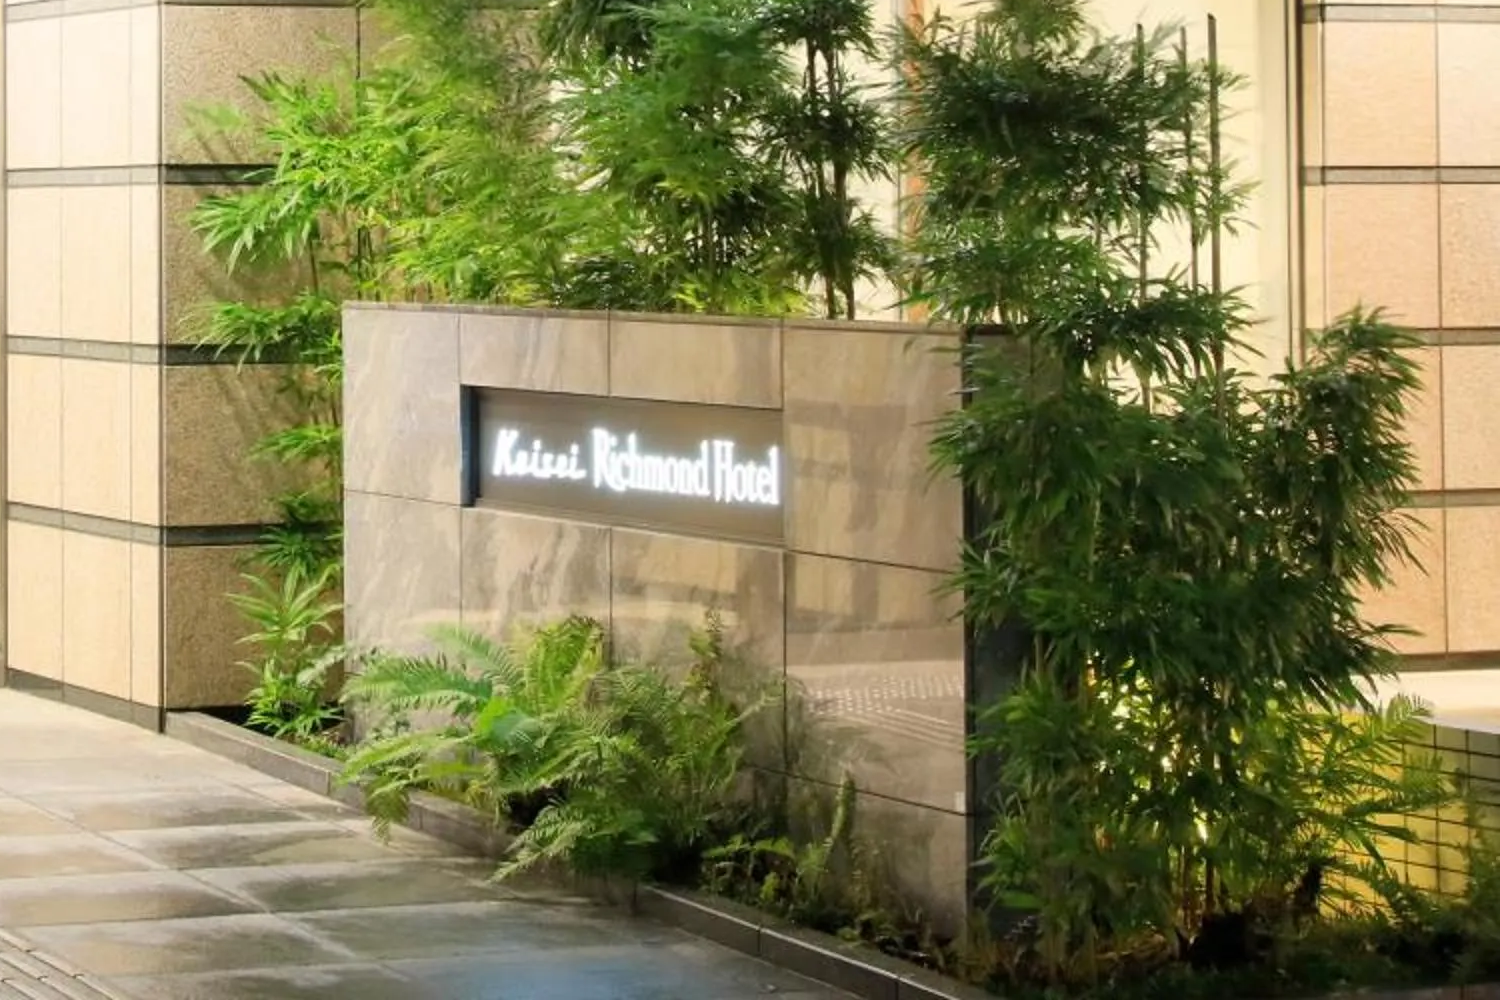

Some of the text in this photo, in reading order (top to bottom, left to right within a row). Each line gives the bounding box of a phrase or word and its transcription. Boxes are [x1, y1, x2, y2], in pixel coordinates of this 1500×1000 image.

[493, 426, 781, 505] Keisei Richmond Hotel
